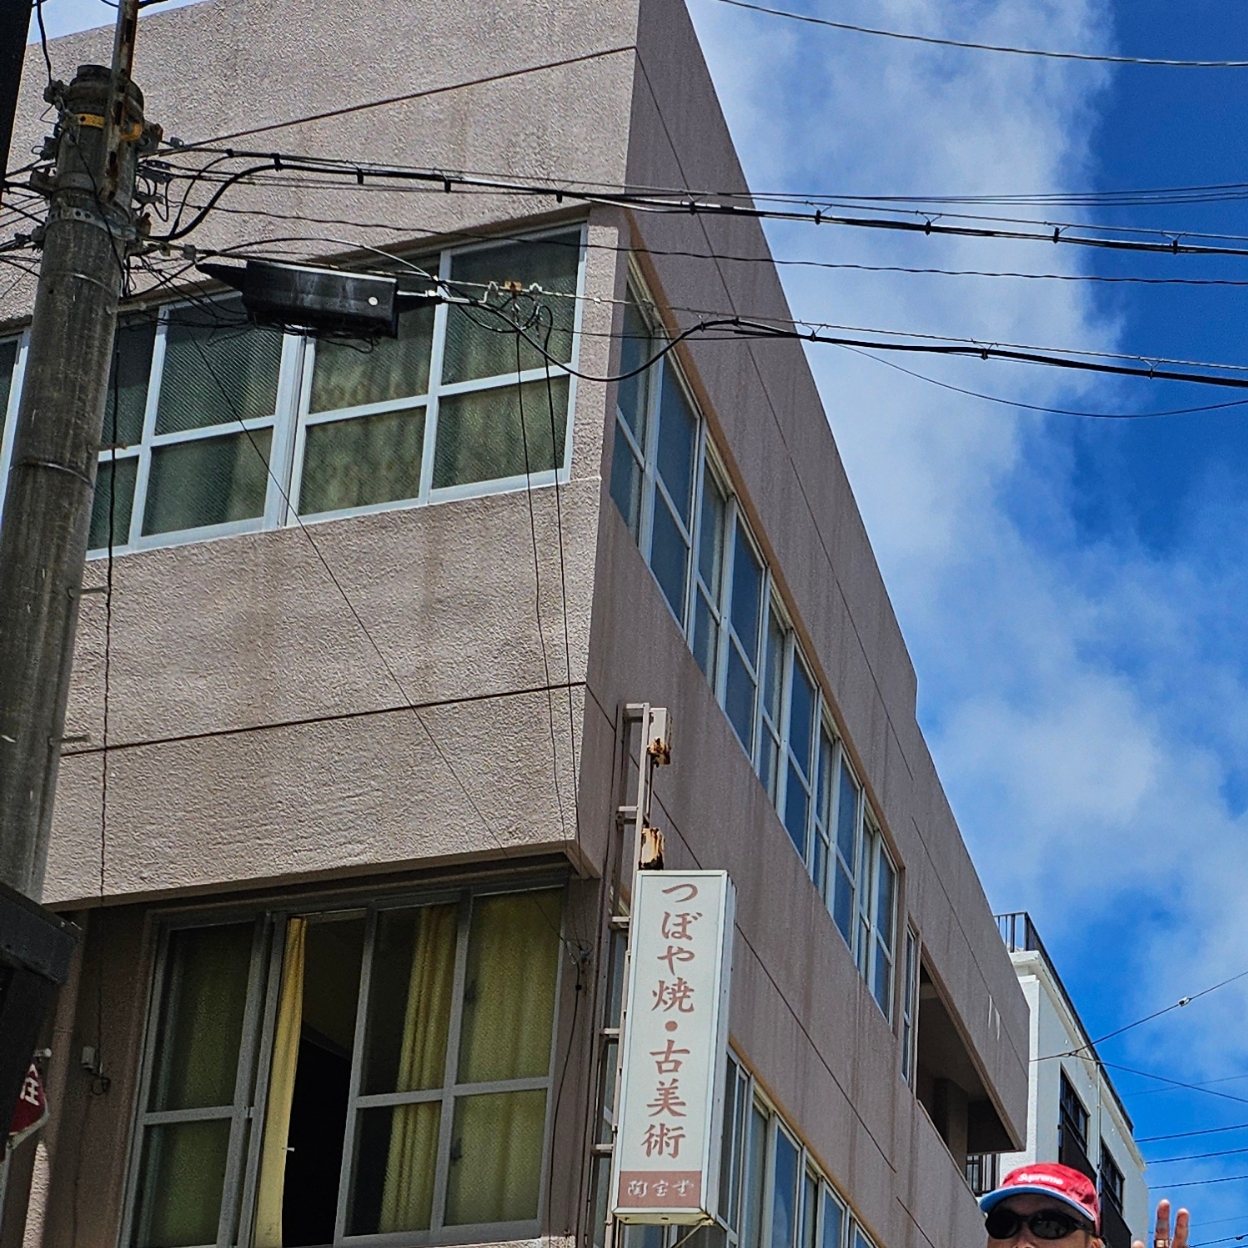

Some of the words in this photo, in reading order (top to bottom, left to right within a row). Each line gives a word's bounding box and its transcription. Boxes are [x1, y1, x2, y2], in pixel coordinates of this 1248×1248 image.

[641, 882, 702, 1158] つぼや焼・古美術
[1017, 1172, 1064, 1186] Supreme
